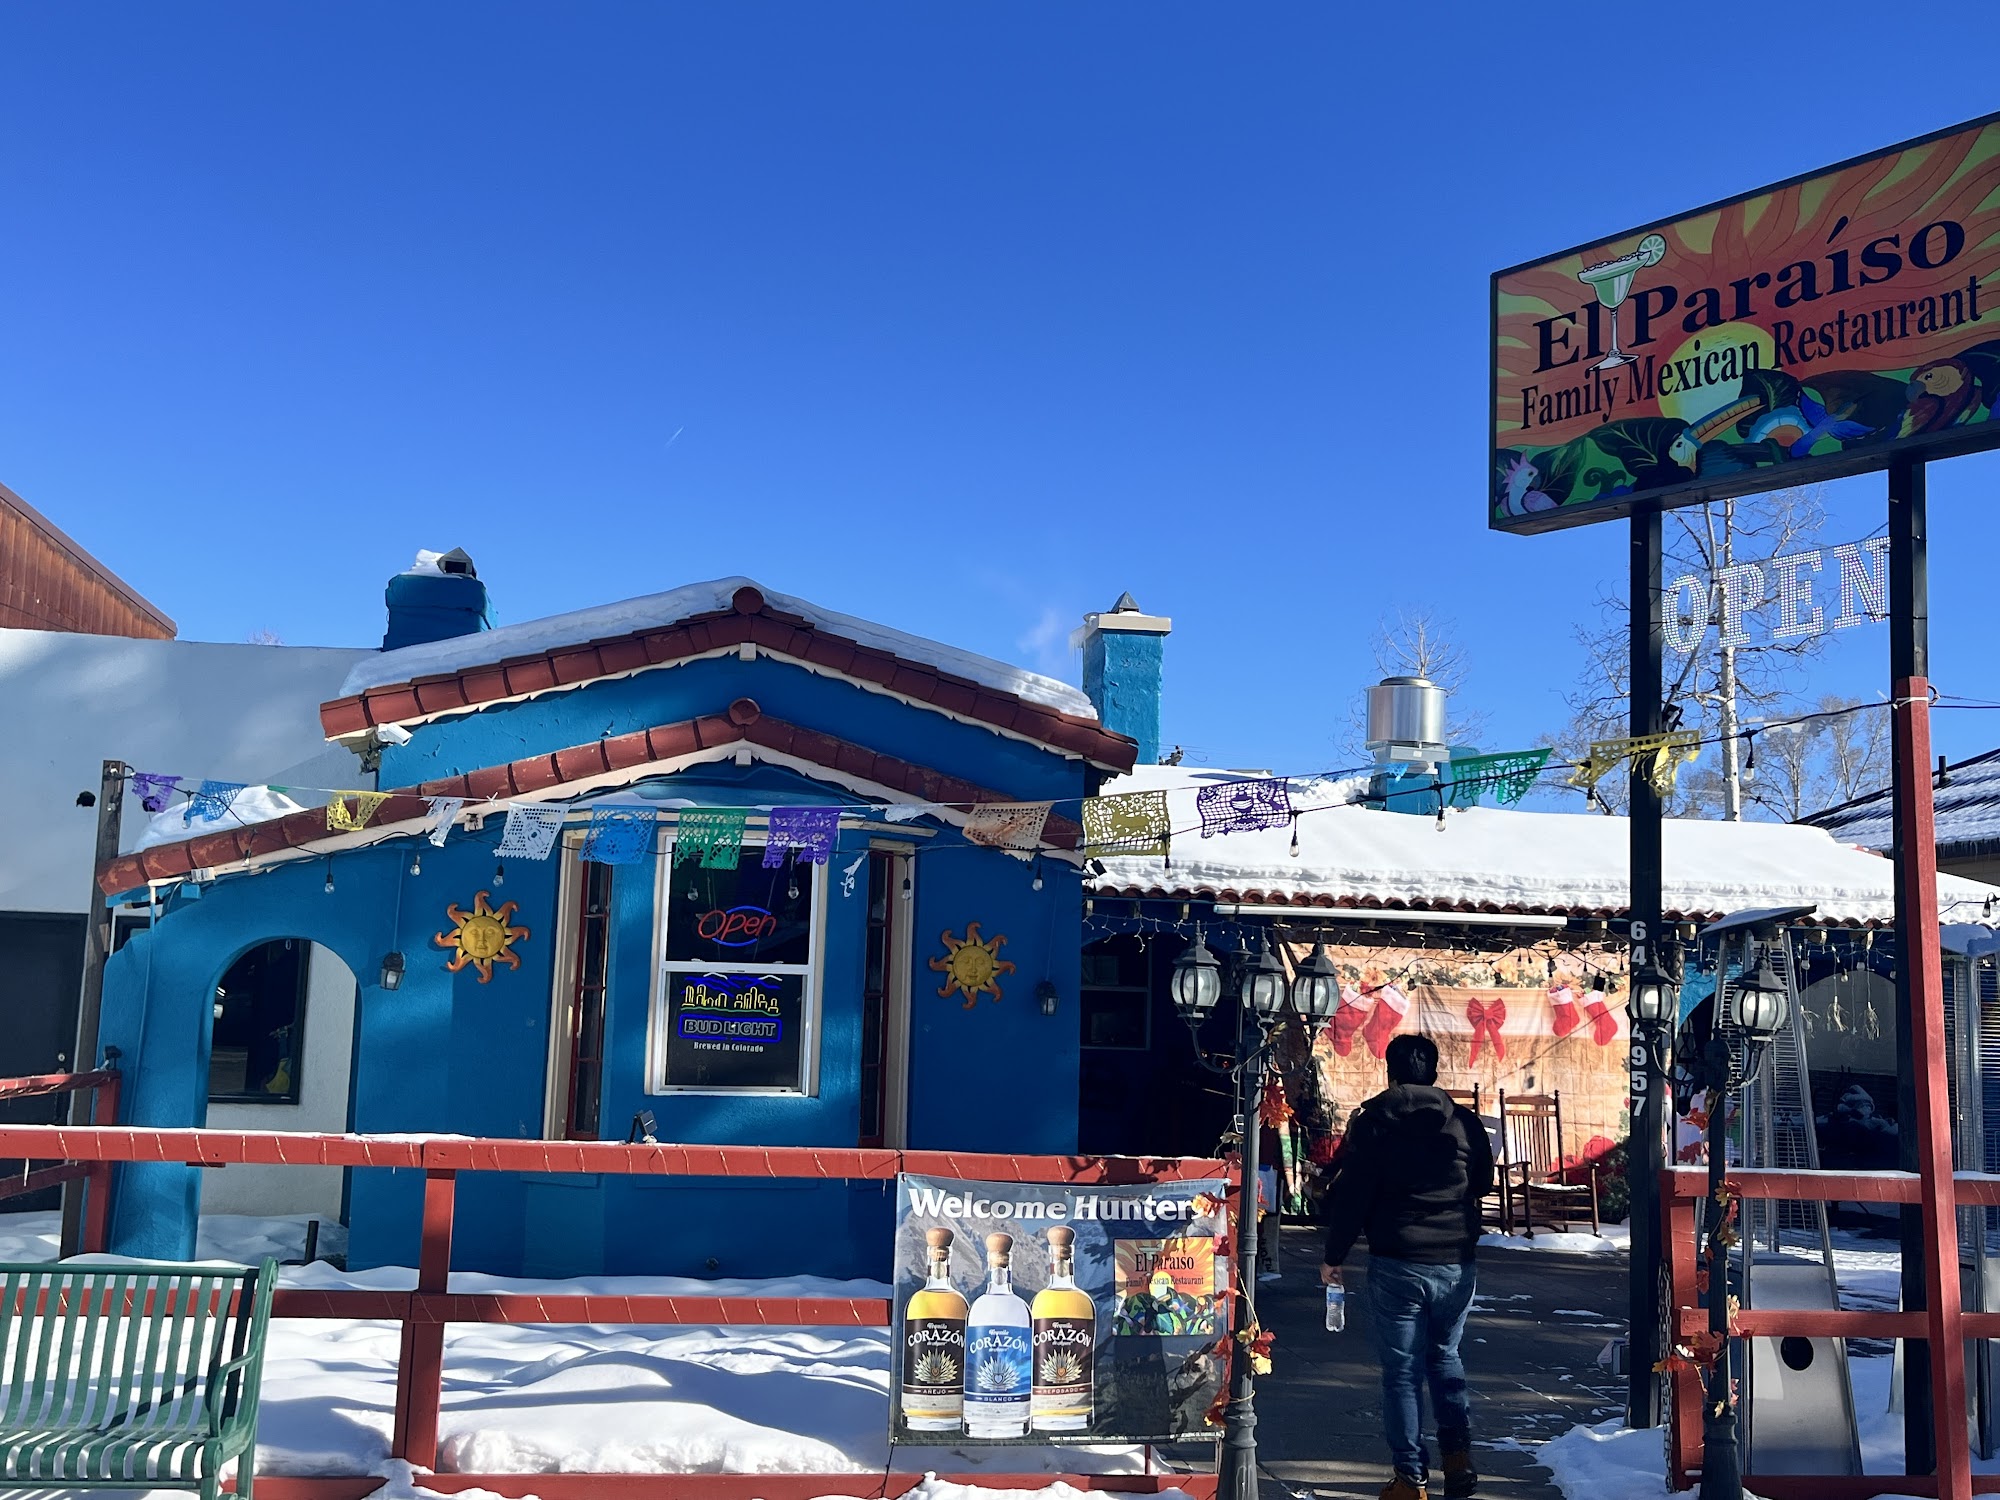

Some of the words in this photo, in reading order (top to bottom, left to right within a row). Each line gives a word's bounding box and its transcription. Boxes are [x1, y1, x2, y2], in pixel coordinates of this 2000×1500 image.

[1531, 299, 1605, 374] El
[1627, 215, 1965, 348] Paraíso
[1520, 366, 1620, 430] Family
[1626, 339, 1760, 405] Mexican
[1770, 275, 1982, 369] Restaurant
[1661, 536, 1891, 653] OPEN
[698, 910, 777, 940] Open
[684, 1019, 722, 1034] BUD
[723, 1020, 776, 1036] LIGHT
[693, 1041, 721, 1051] Brewed
[731, 1043, 764, 1053] Colorado
[907, 1188, 1067, 1220] Welcome
[1134, 1252, 1148, 1272] El
[1170, 1275, 1203, 1285] Restaurant
[907, 1328, 965, 1349] CORAZÓN
[969, 1335, 1028, 1354] CORAZÓN
[1033, 1328, 1092, 1348] CORAZÓN
